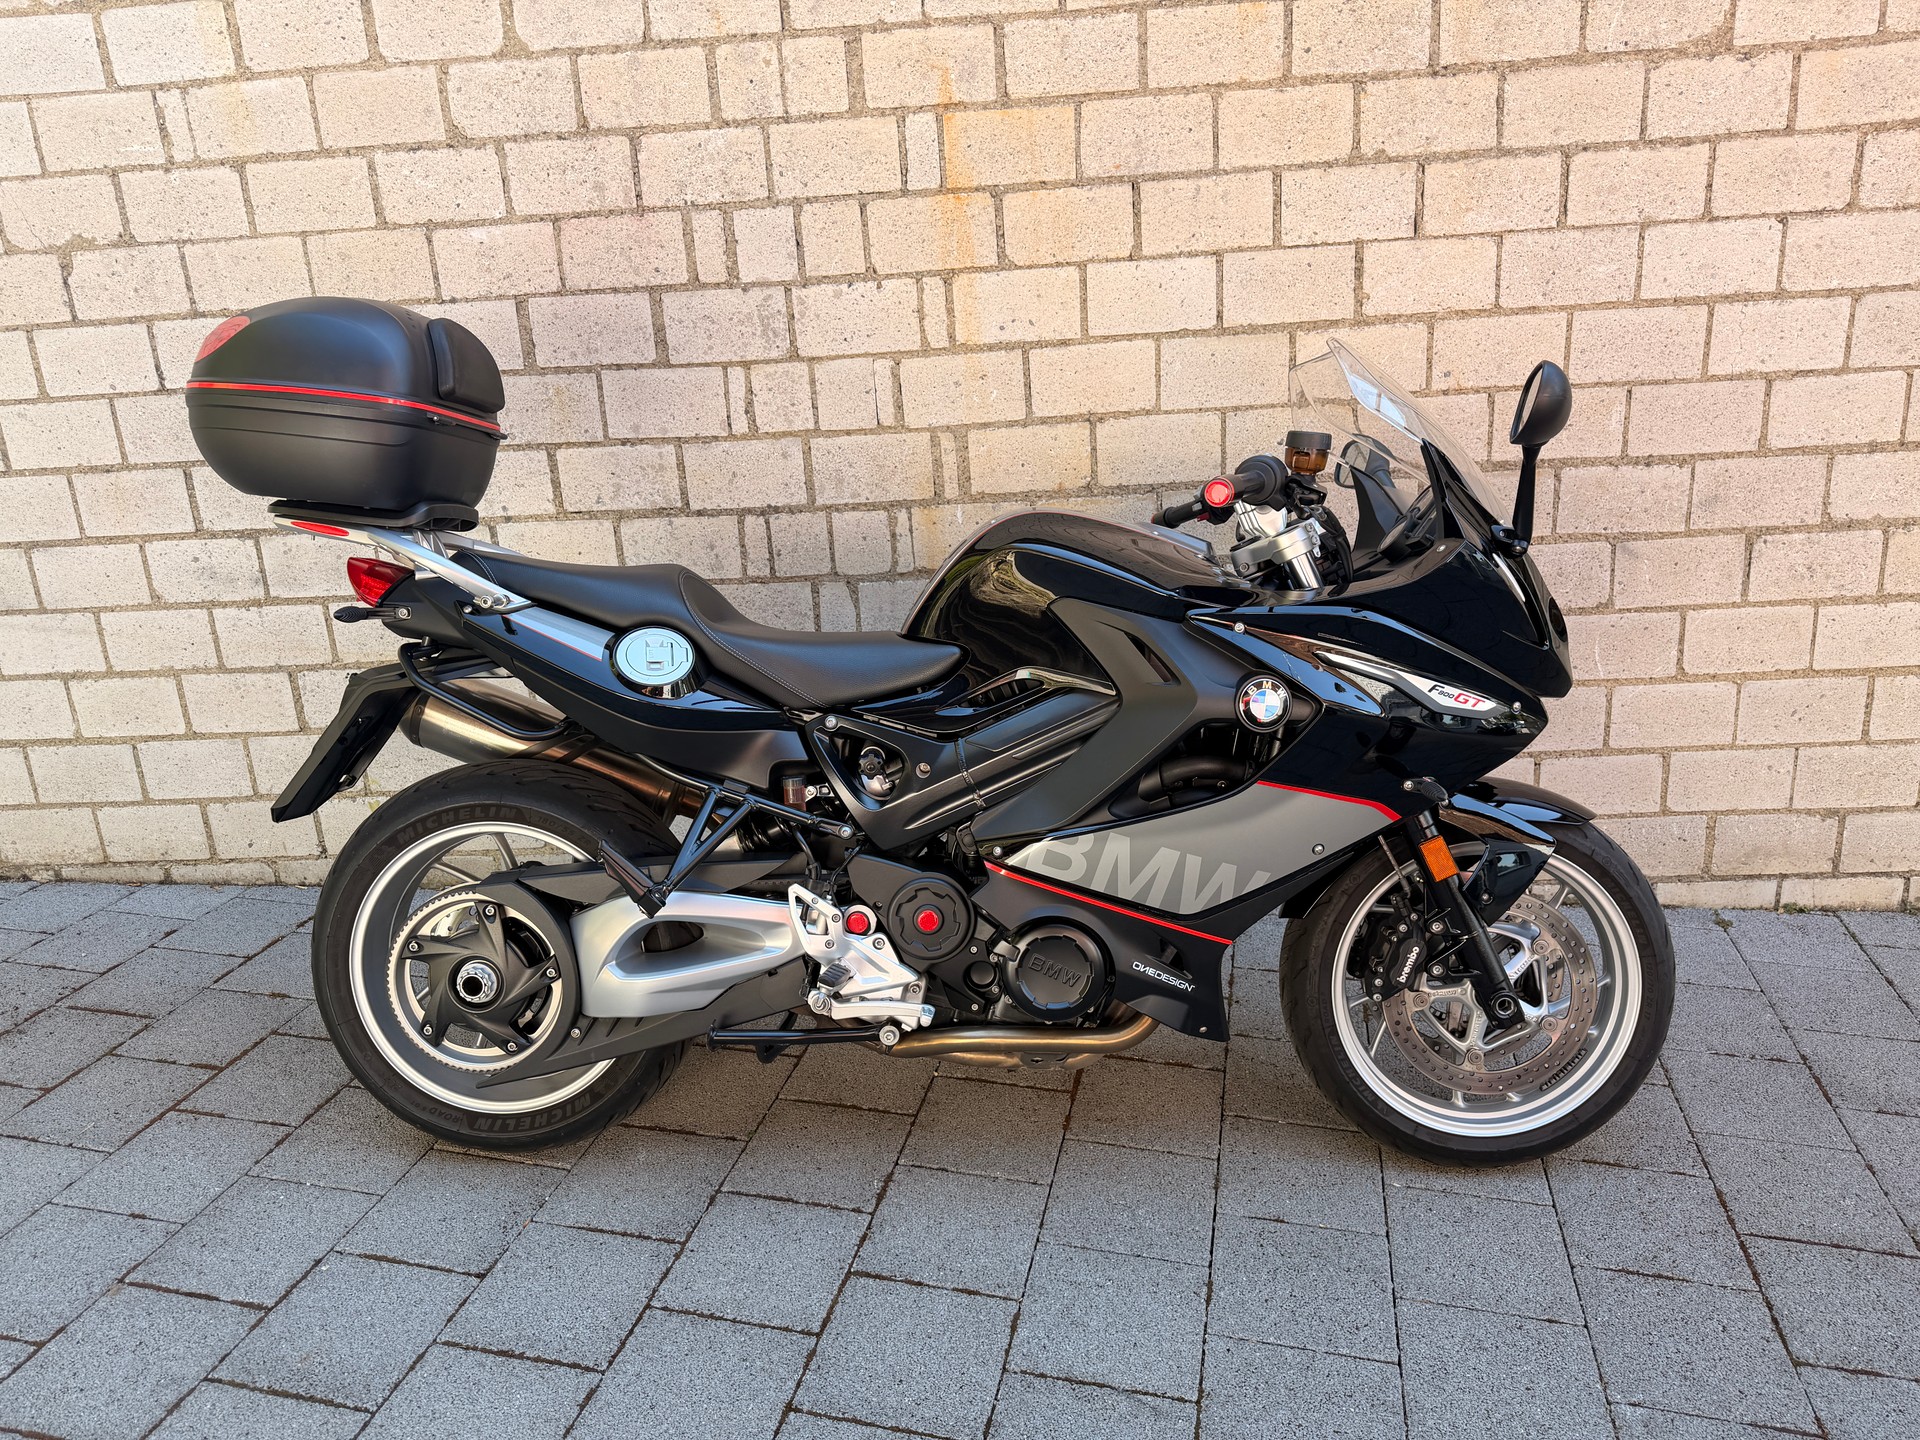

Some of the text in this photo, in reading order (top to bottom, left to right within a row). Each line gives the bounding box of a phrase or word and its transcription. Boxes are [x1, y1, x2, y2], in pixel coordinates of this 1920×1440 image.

[1246, 680, 1288, 698] BMW
[396, 806, 518, 845] MICHELIN
[1025, 832, 1271, 915] BMW
[1028, 953, 1082, 987] BMW
[1396, 946, 1420, 984] brembo
[473, 1095, 591, 1131] MICHELIN
